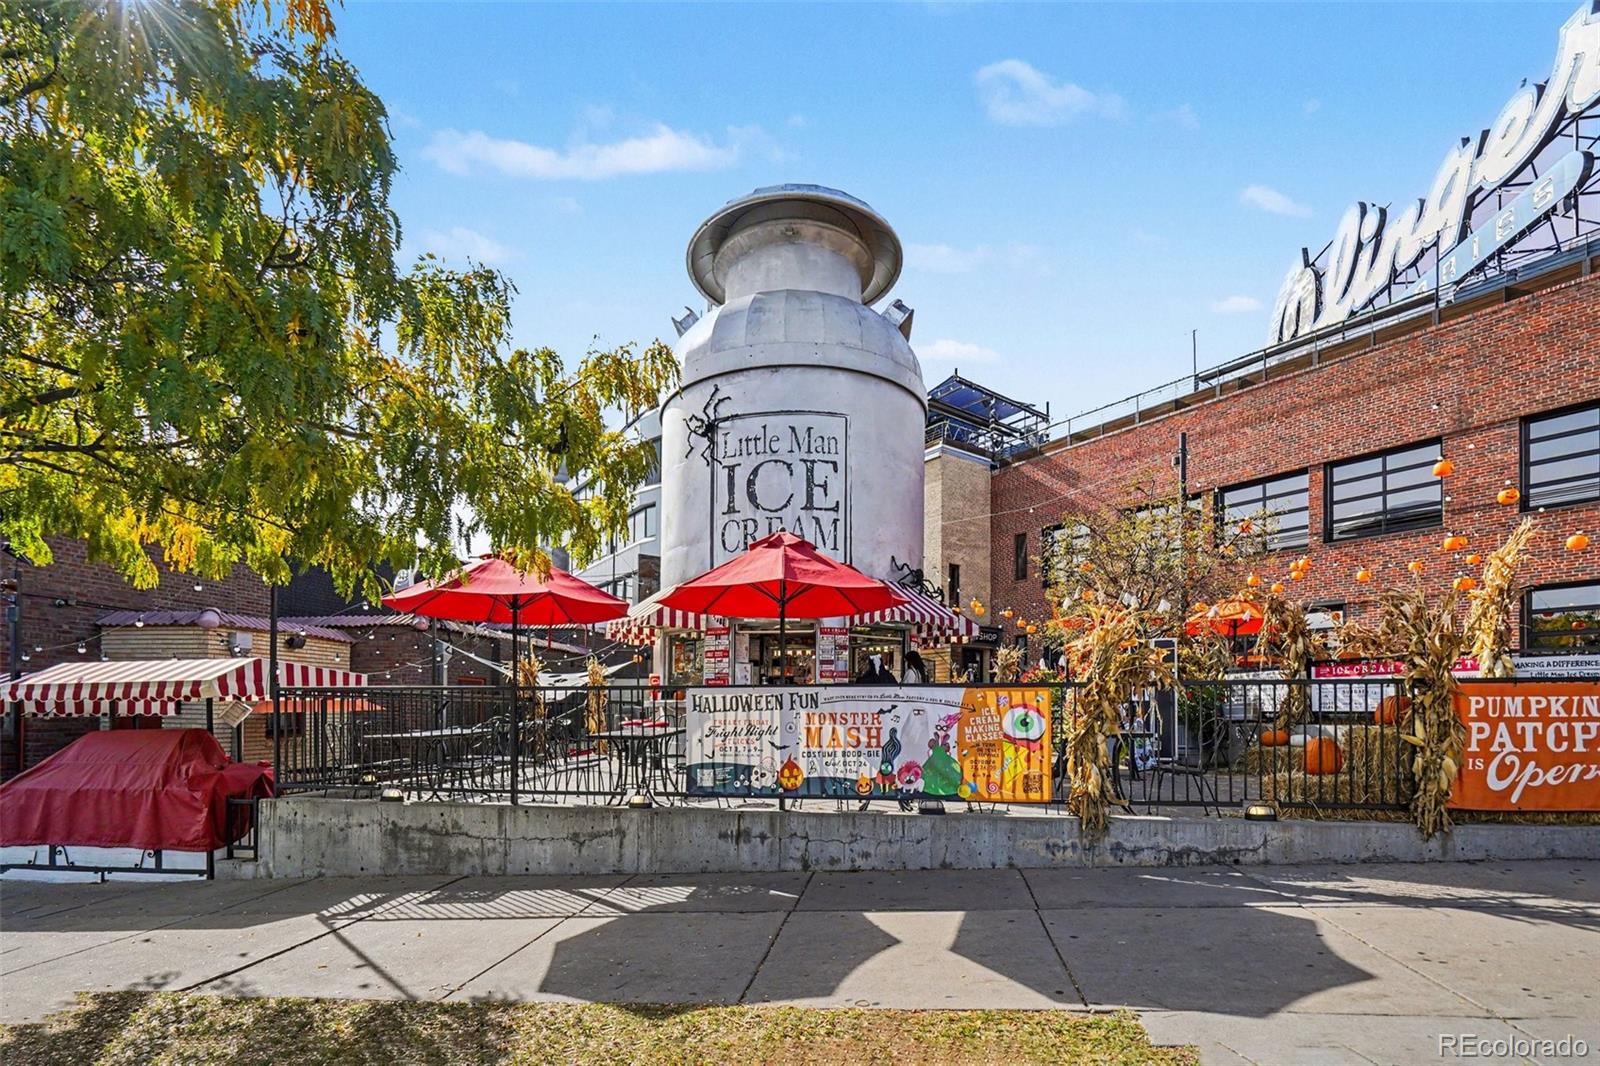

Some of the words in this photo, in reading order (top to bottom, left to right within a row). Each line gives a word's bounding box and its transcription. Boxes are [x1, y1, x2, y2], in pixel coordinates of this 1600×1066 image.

[721, 424, 780, 459] Little
[788, 425, 839, 456] Man
[721, 458, 840, 515] ICE
[1332, 666, 1350, 675] ICE
[1514, 661, 1544, 669] MAKING
[1552, 660, 1600, 668] DIFFERENCE
[691, 693, 784, 713] HALLOWEEN
[788, 692, 819, 711] FUN
[1468, 695, 1600, 718] PUMPKIN
[981, 707, 997, 716] ICE
[805, 712, 882, 726] MONSTER
[969, 715, 1001, 725] CREAM
[705, 725, 744, 743] Fright
[744, 723, 779, 741] Night
[964, 724, 1000, 735] MAKING
[804, 726, 884, 749] MASH
[965, 731, 1005, 742] CLASSES
[801, 750, 838, 758] COSTUME
[1468, 758, 1485, 770] IS
